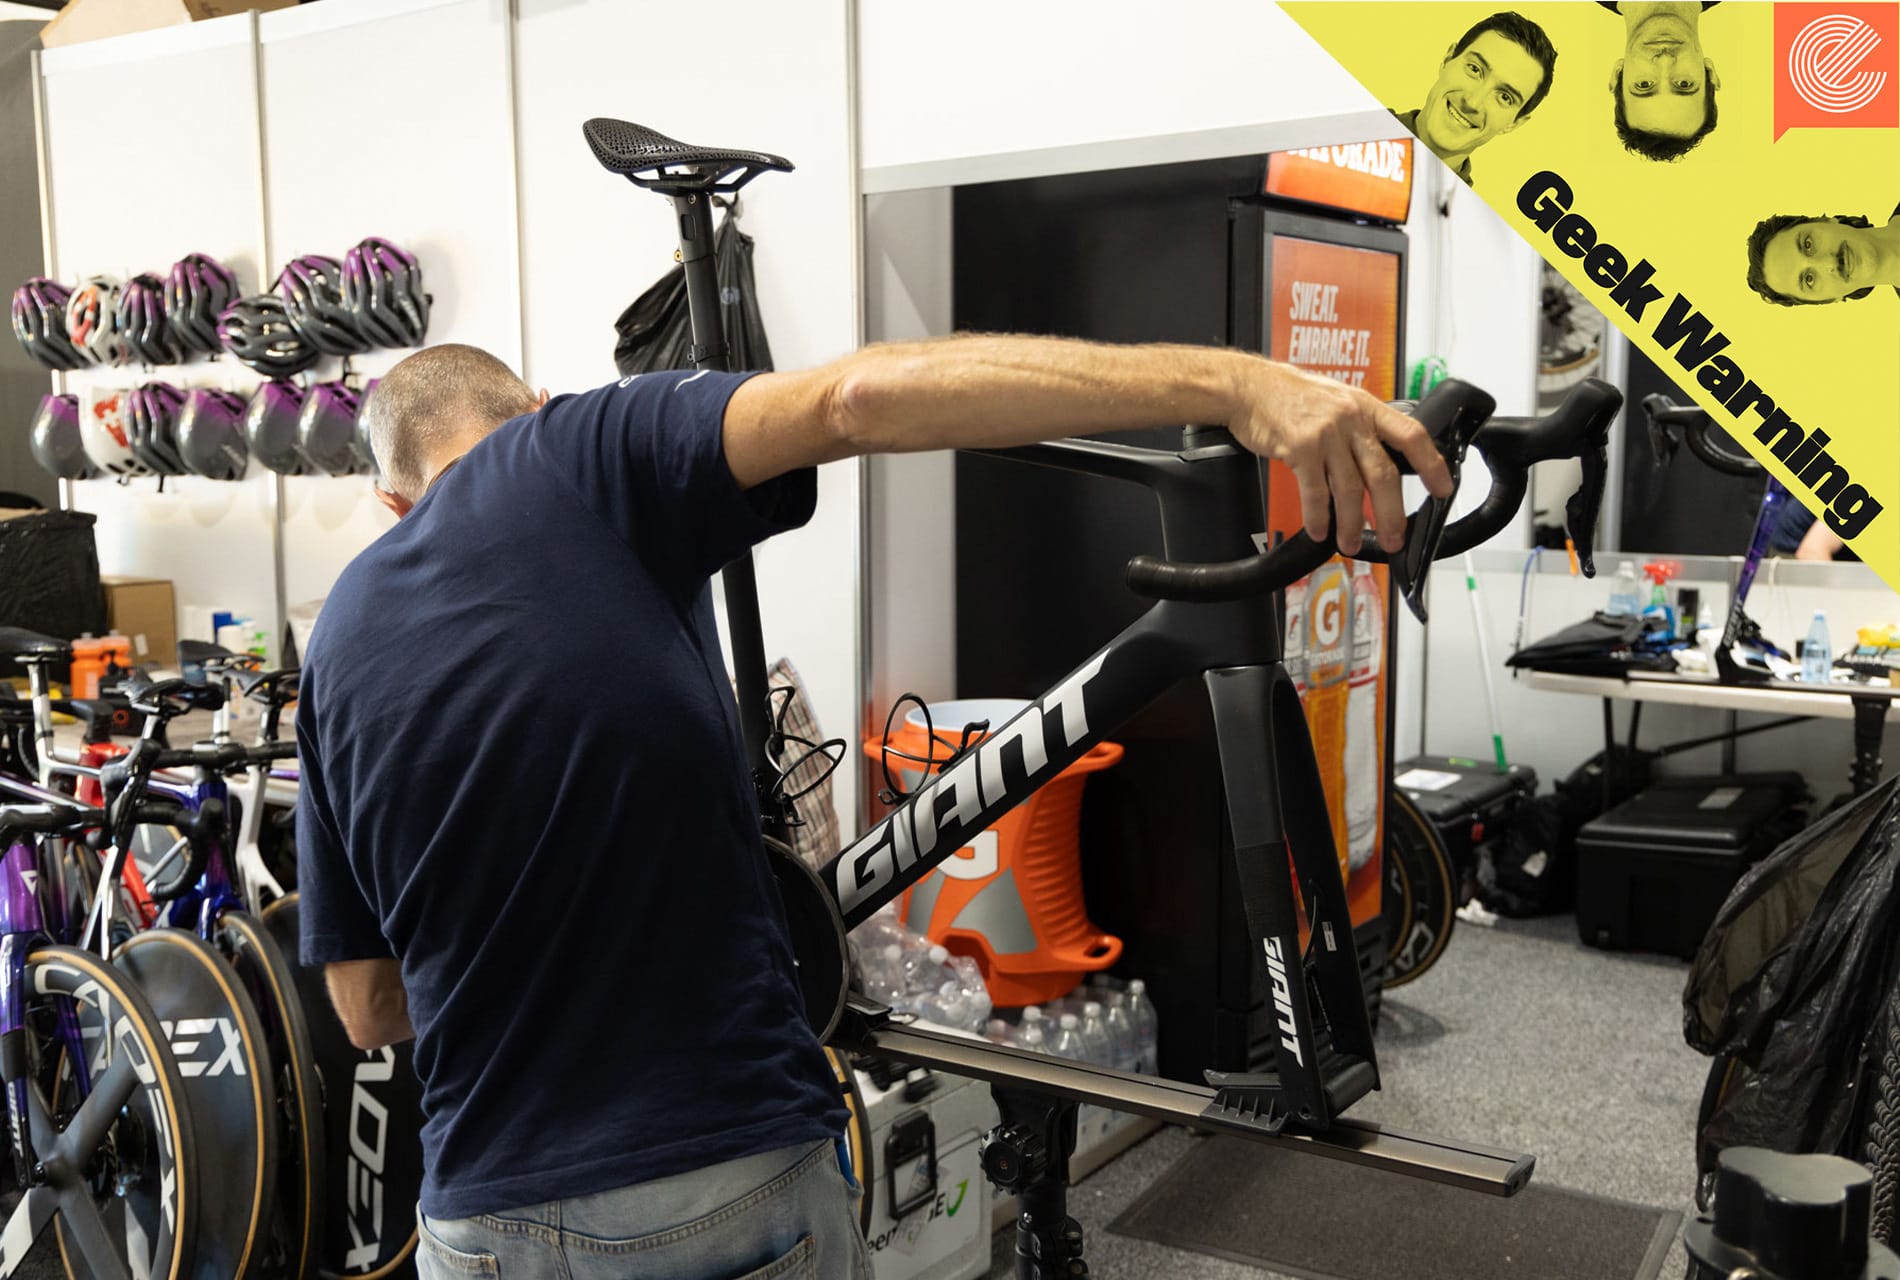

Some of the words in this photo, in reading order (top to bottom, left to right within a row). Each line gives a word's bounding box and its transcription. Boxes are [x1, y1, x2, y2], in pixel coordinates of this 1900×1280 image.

[1289, 281, 1339, 323] SWEAT.
[1288, 325, 1356, 366] EMBRACE
[1354, 330, 1371, 367] IT.
[1315, 587, 1341, 646] G
[836, 647, 1111, 916] GIANT
[1263, 937, 1304, 1068] GIANT
